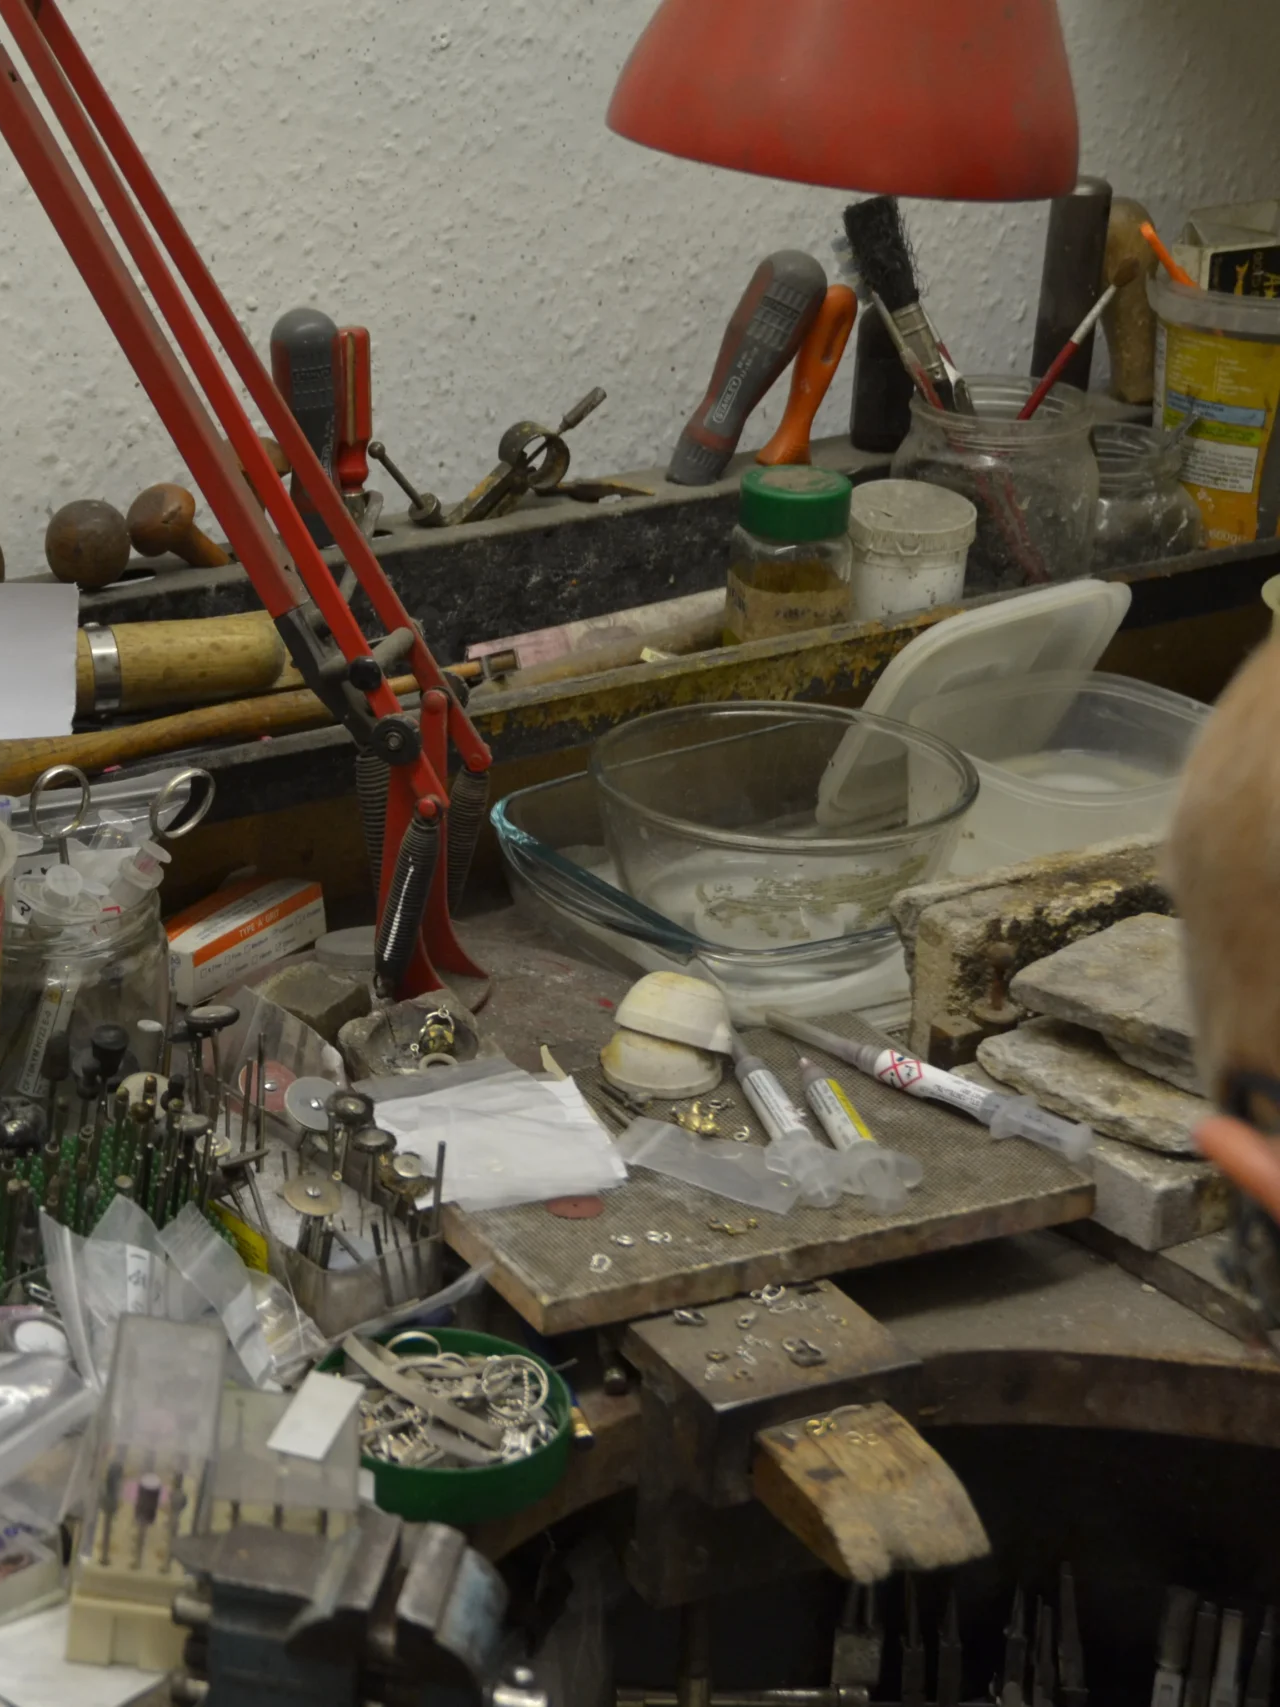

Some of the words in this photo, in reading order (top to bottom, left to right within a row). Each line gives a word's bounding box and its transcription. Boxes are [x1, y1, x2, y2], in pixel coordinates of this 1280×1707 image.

[715, 379, 739, 420] STANLEY
[239, 924, 256, 938] TYPE
[265, 908, 281, 925] GRIT
